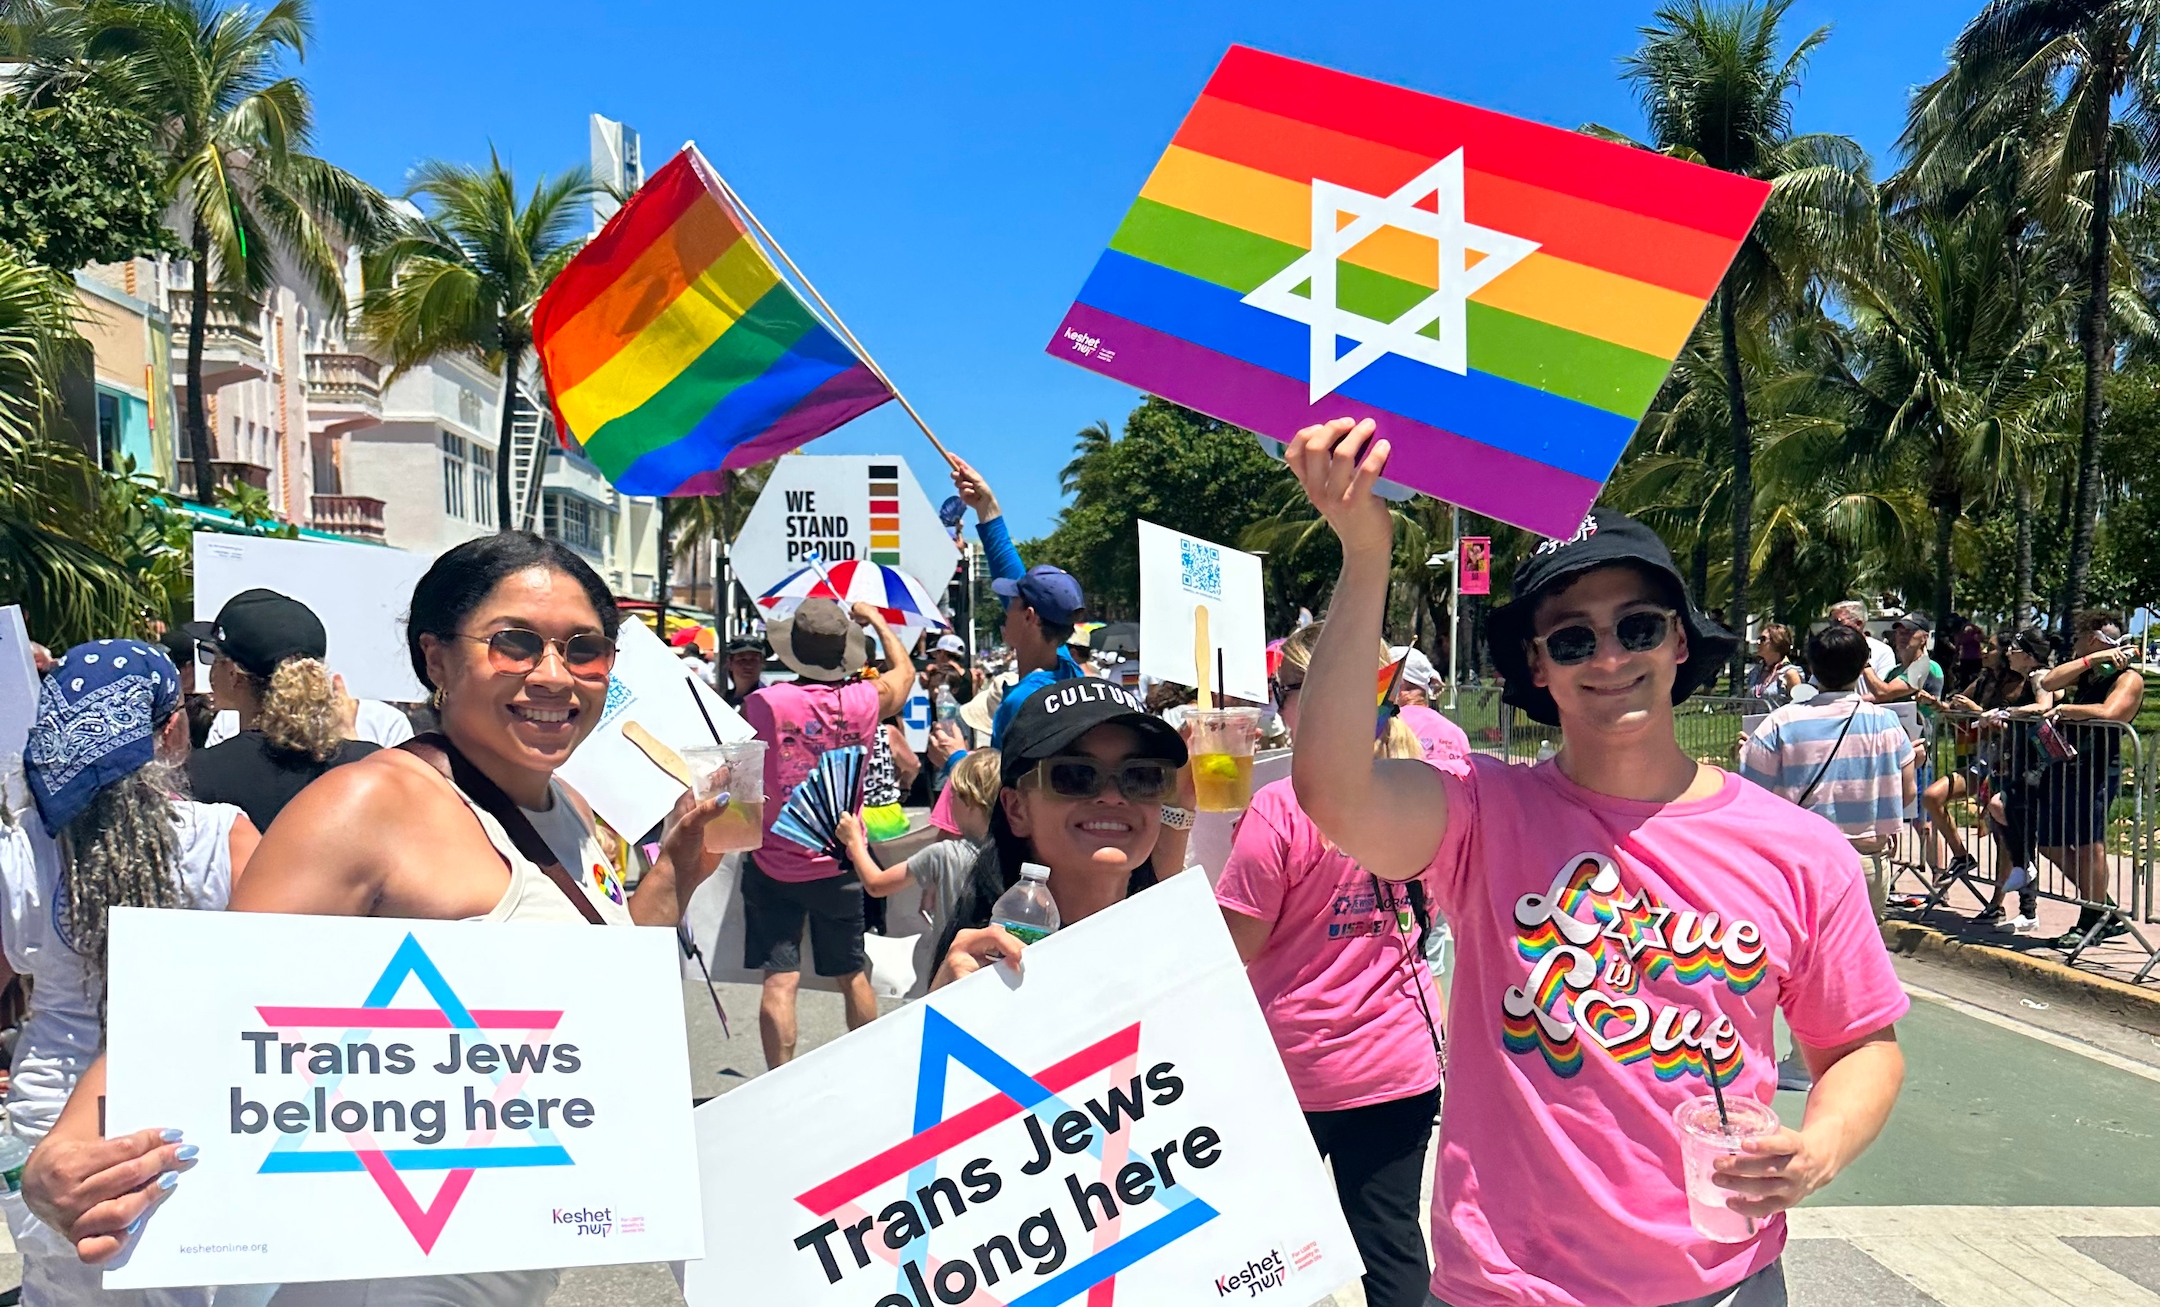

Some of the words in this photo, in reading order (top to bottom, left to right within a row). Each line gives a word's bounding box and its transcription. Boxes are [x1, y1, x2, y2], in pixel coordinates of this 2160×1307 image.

[1064, 326, 1101, 349] Keshet
[785, 490, 816, 513] WE
[786, 515, 849, 538] STAND
[787, 541, 855, 562] PROUD
[1044, 683, 1144, 714] CULTUR
[1604, 953, 1636, 989] is
[241, 1031, 416, 1075] Trans
[433, 1032, 581, 1075] Jews
[230, 1086, 446, 1145] belong
[465, 1086, 595, 1130] here
[793, 1157, 1002, 1285] Trans
[1020, 1062, 1222, 1176] Jews
[552, 1207, 612, 1224] Keshet
[577, 1223, 612, 1238] קשת
[874, 1207, 1067, 1307] long
[1065, 1126, 1222, 1232] here
[180, 1243, 269, 1254] keshetonline.org
[1215, 1249, 1282, 1297] Keshet
[1248, 1266, 1285, 1298] קשת
